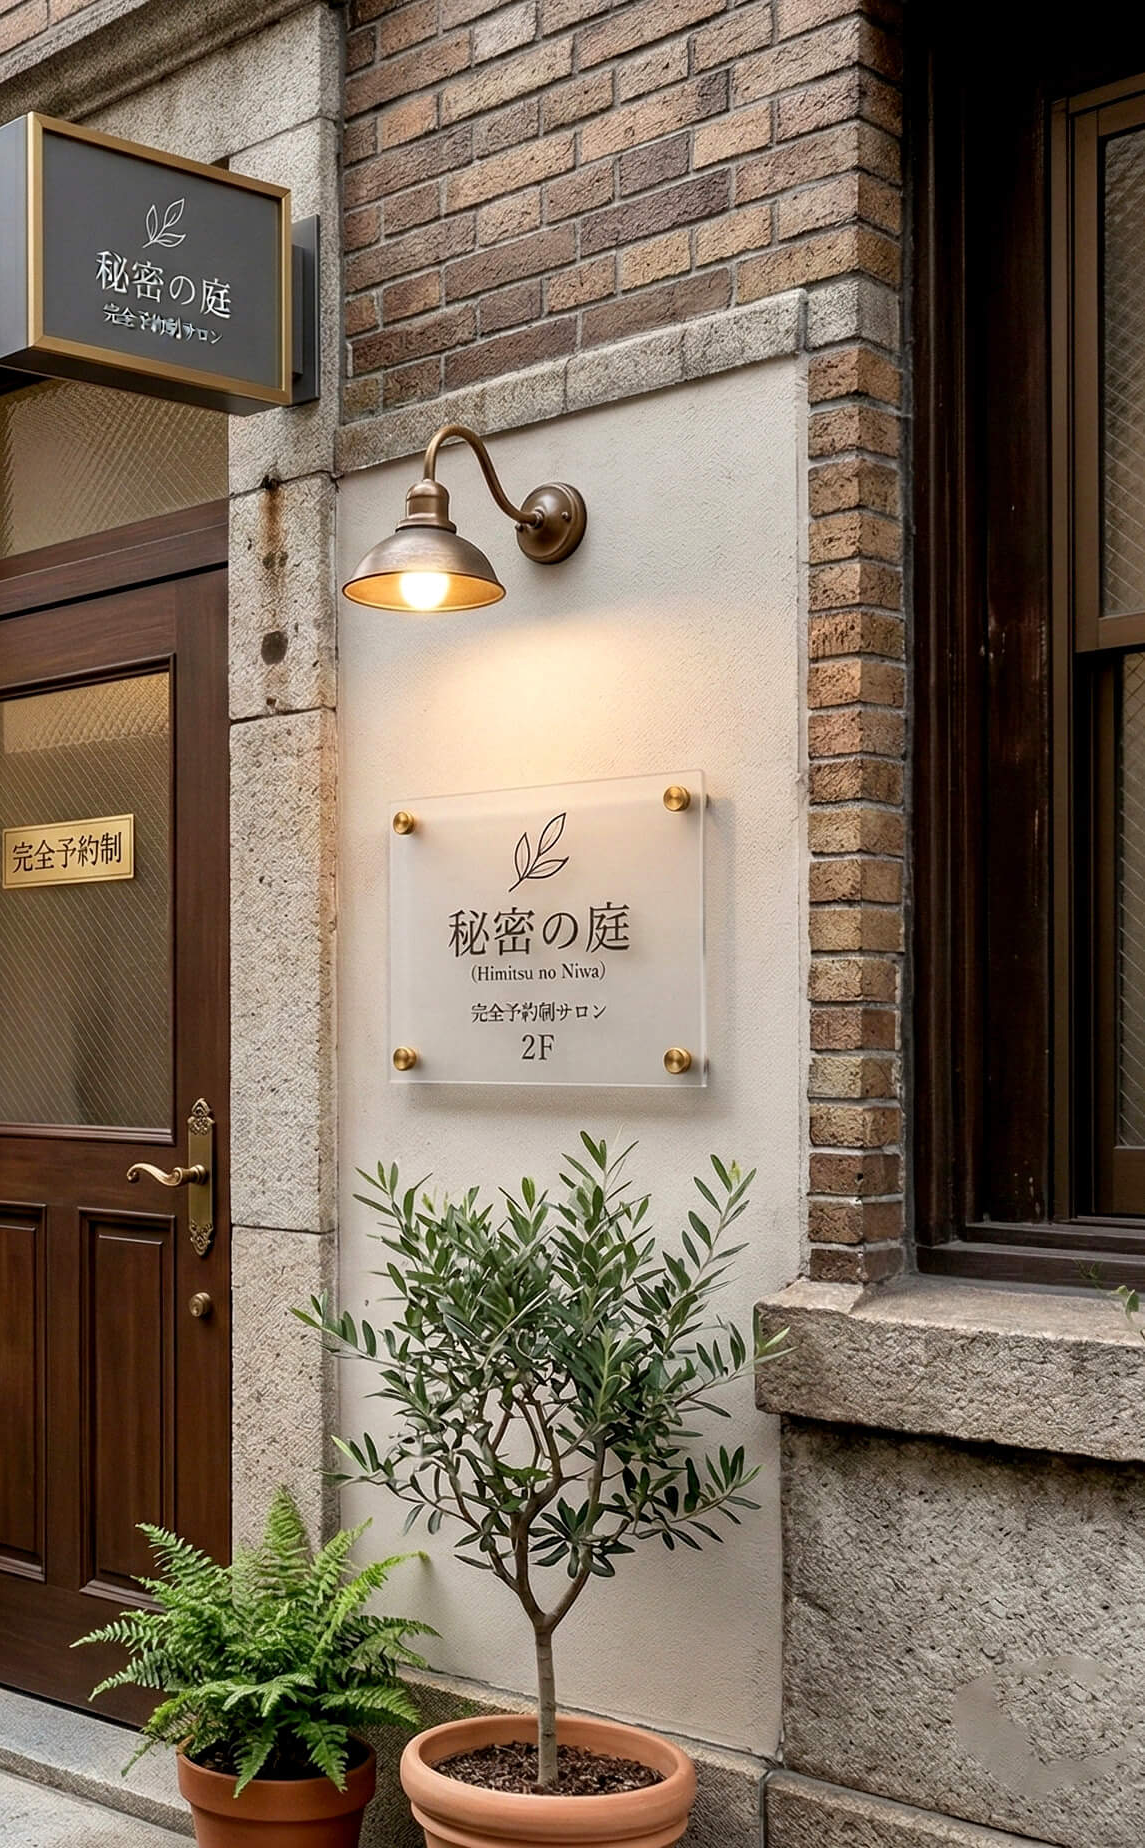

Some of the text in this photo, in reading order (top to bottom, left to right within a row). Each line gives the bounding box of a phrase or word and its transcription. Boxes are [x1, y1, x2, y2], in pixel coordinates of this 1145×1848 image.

[95, 250, 232, 319] 秘密の庭
[11, 831, 122, 873] 完全予約制
[448, 901, 631, 958] 秘密の庭
[471, 960, 606, 983] (Himitsu no Niwa)
[521, 1033, 555, 1061] 2F
